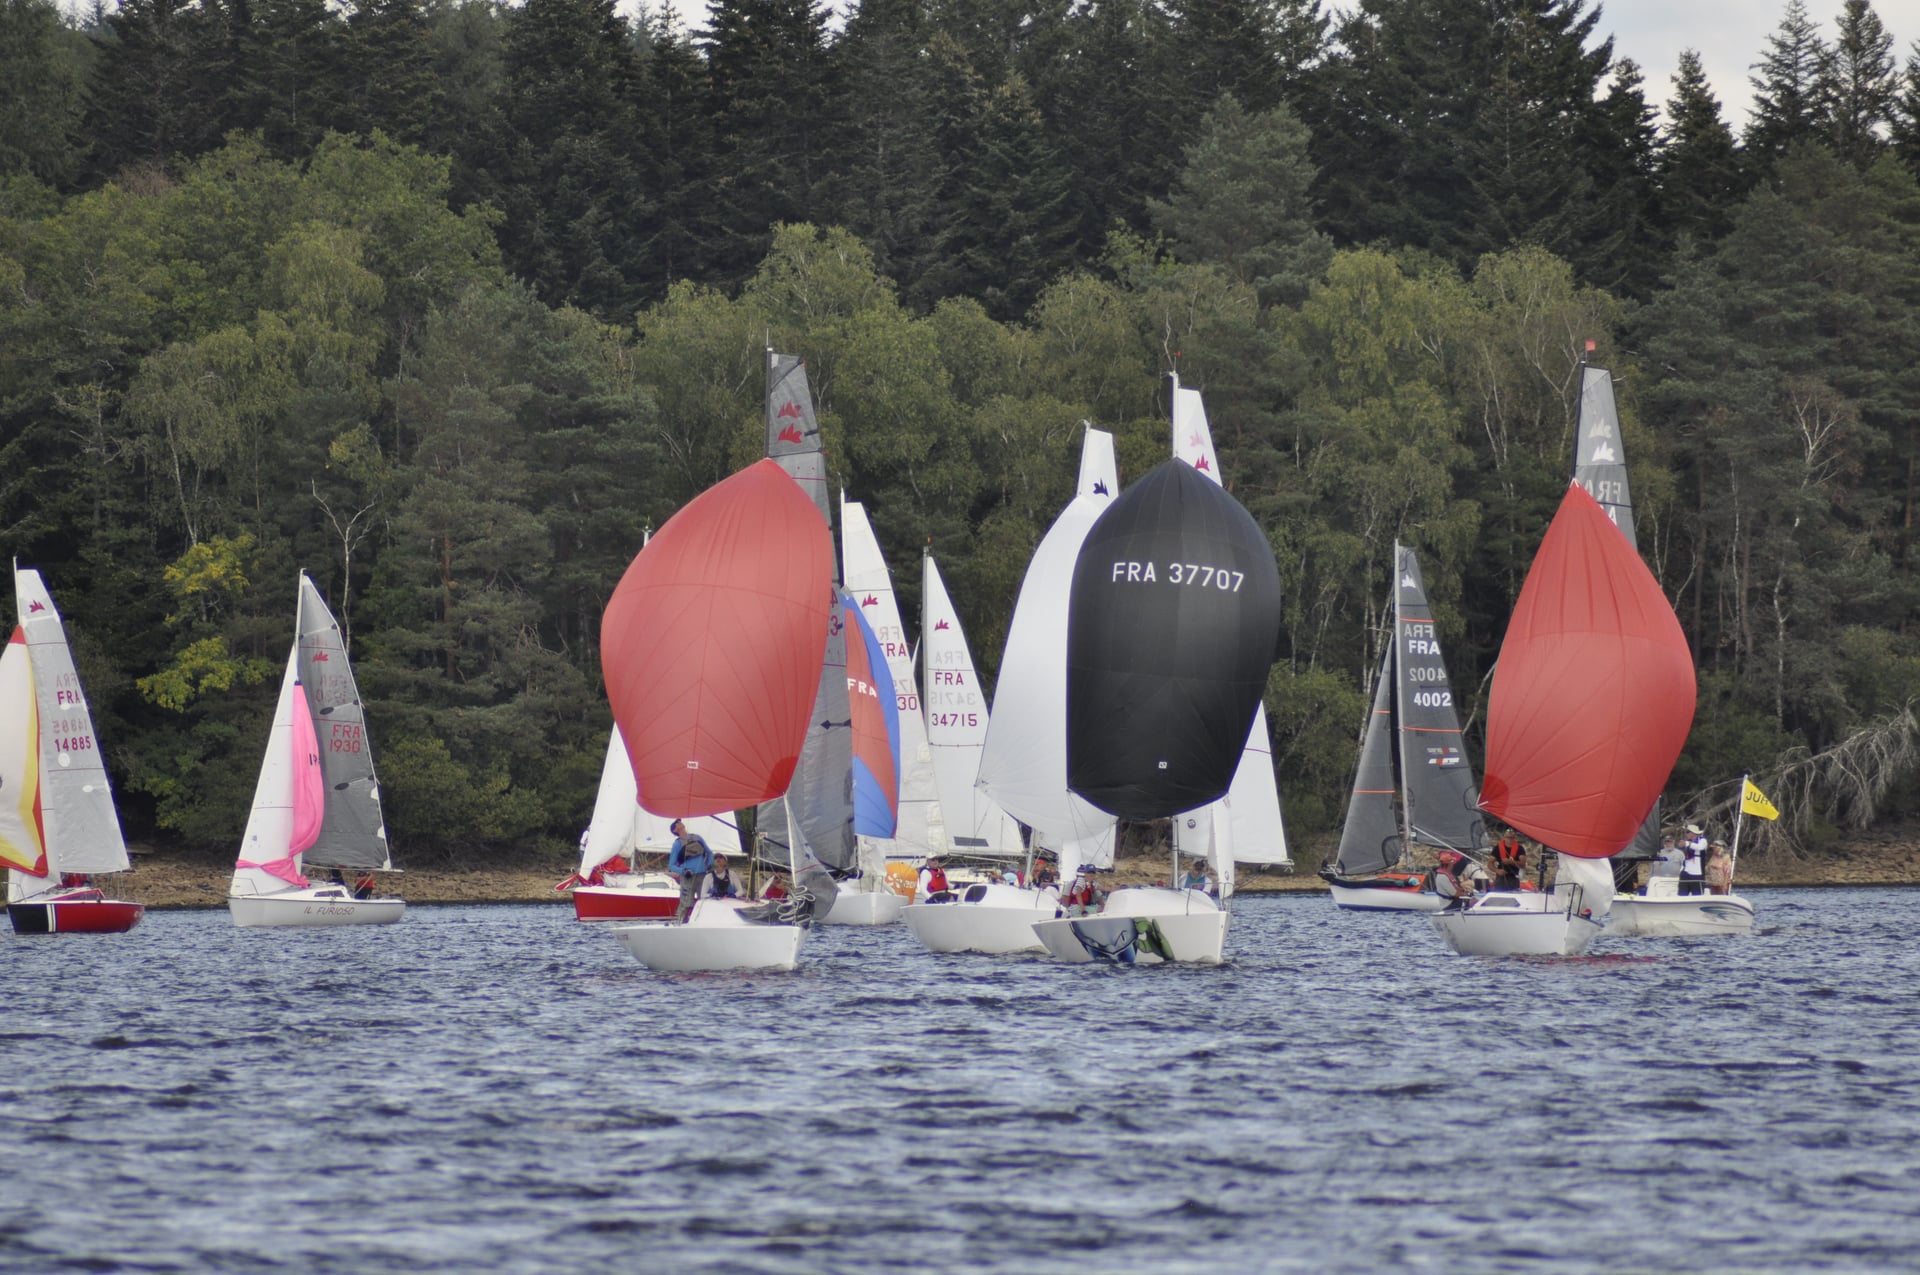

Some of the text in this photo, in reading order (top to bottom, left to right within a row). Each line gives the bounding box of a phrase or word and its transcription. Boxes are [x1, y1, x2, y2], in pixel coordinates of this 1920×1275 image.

[1112, 561, 1244, 592] FRA 37707
[1408, 639, 1441, 655] FRA
[935, 672, 964, 686] FRA
[847, 678, 877, 698] FRA
[57, 690, 80, 706] FRA
[1413, 692, 1452, 707] 4002
[931, 713, 978, 727] 34715
[333, 724, 361, 738] FRA
[54, 736, 91, 752] 14885
[329, 739, 361, 753] 1930
[303, 906, 355, 916] IL FURIOSO
